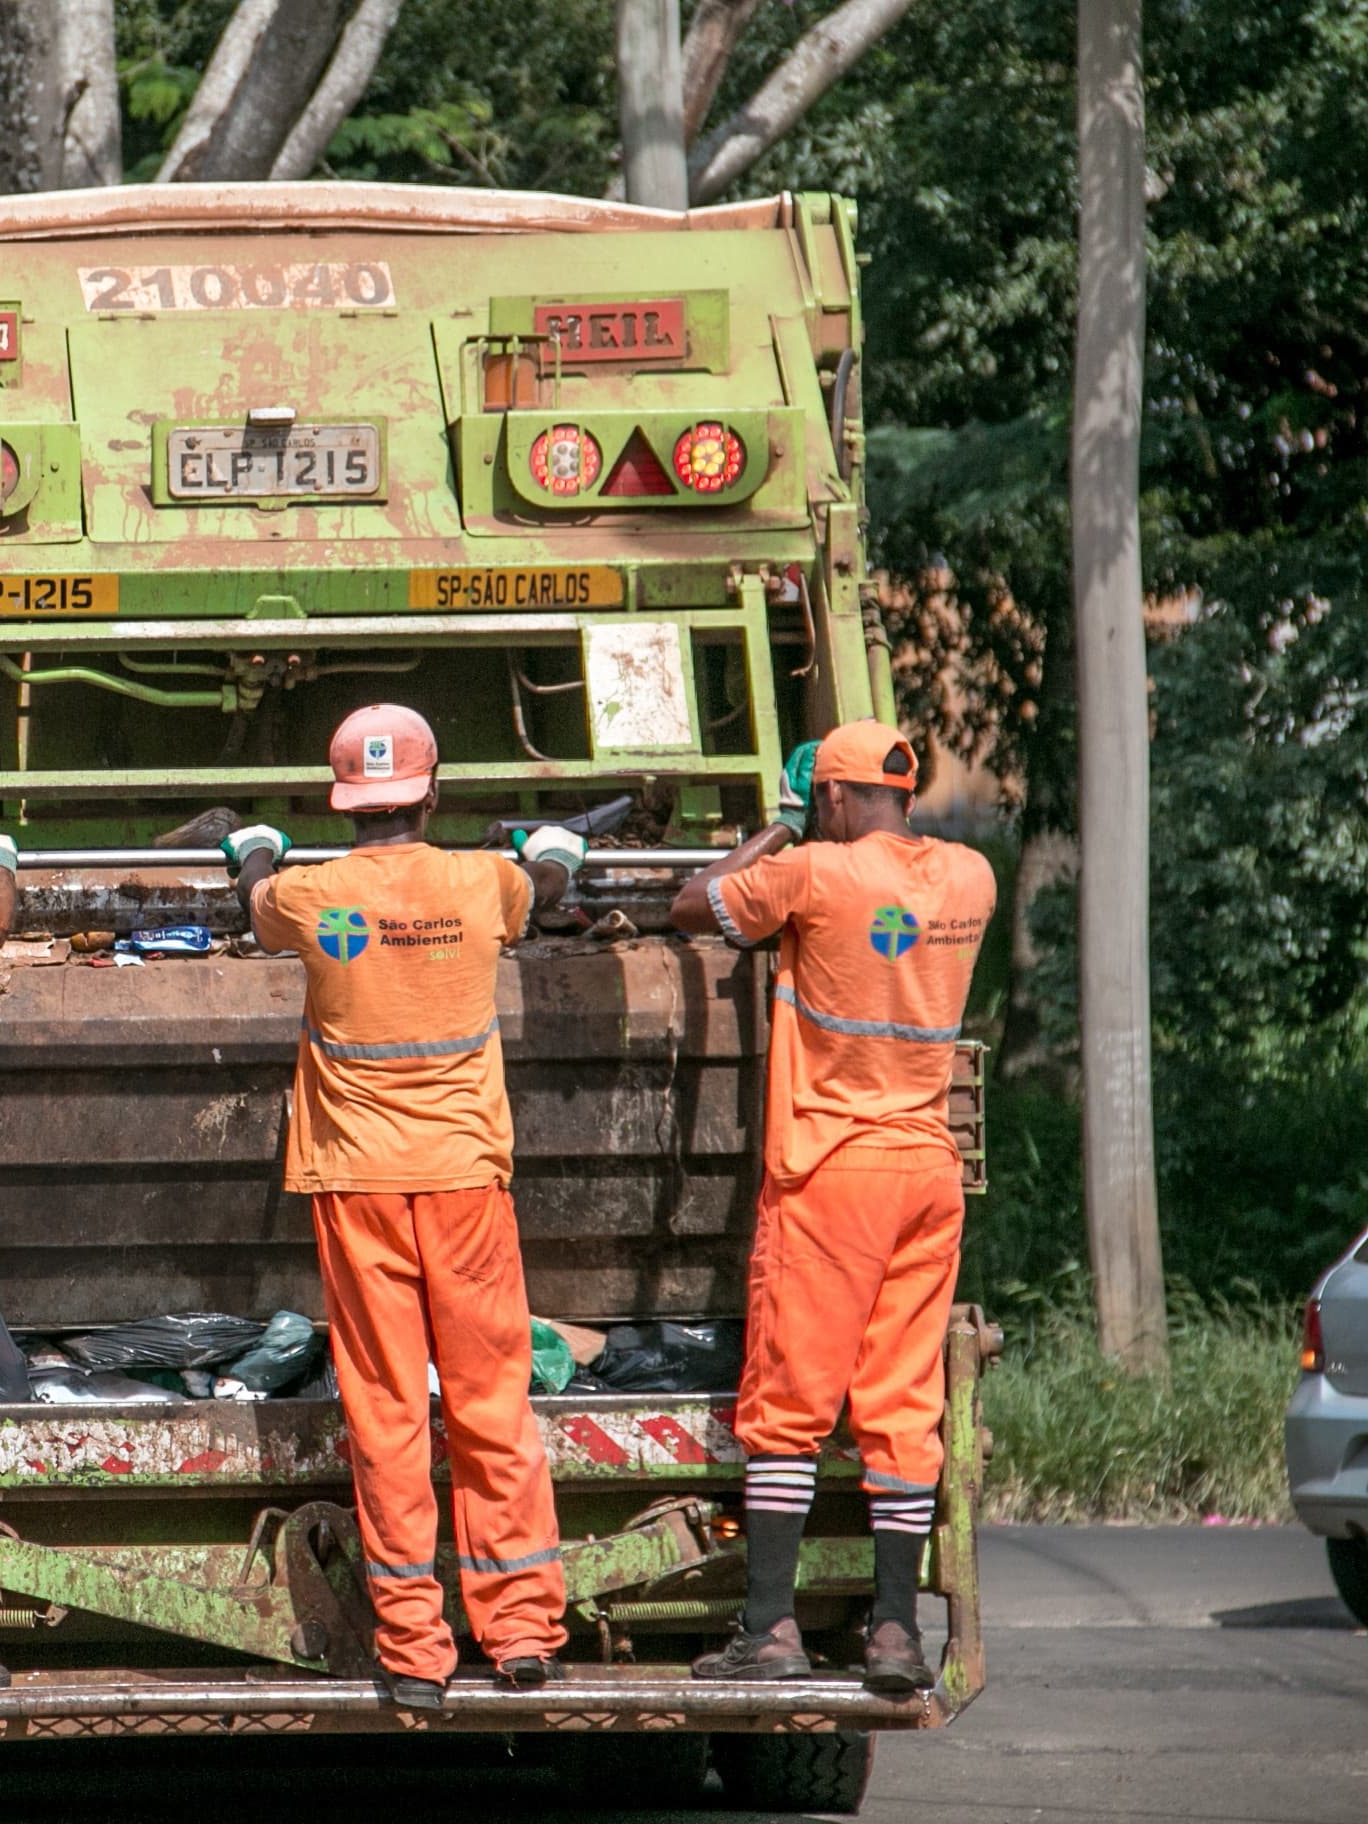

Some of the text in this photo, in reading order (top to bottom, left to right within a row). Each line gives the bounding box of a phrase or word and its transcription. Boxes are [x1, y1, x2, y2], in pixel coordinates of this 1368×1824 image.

[86, 263, 391, 310] 210040
[546, 311, 674, 350] HEIL
[515, 572, 591, 605] CARLOS
[378, 917, 462, 931] São Carlos
[380, 931, 463, 947] Ambiental
